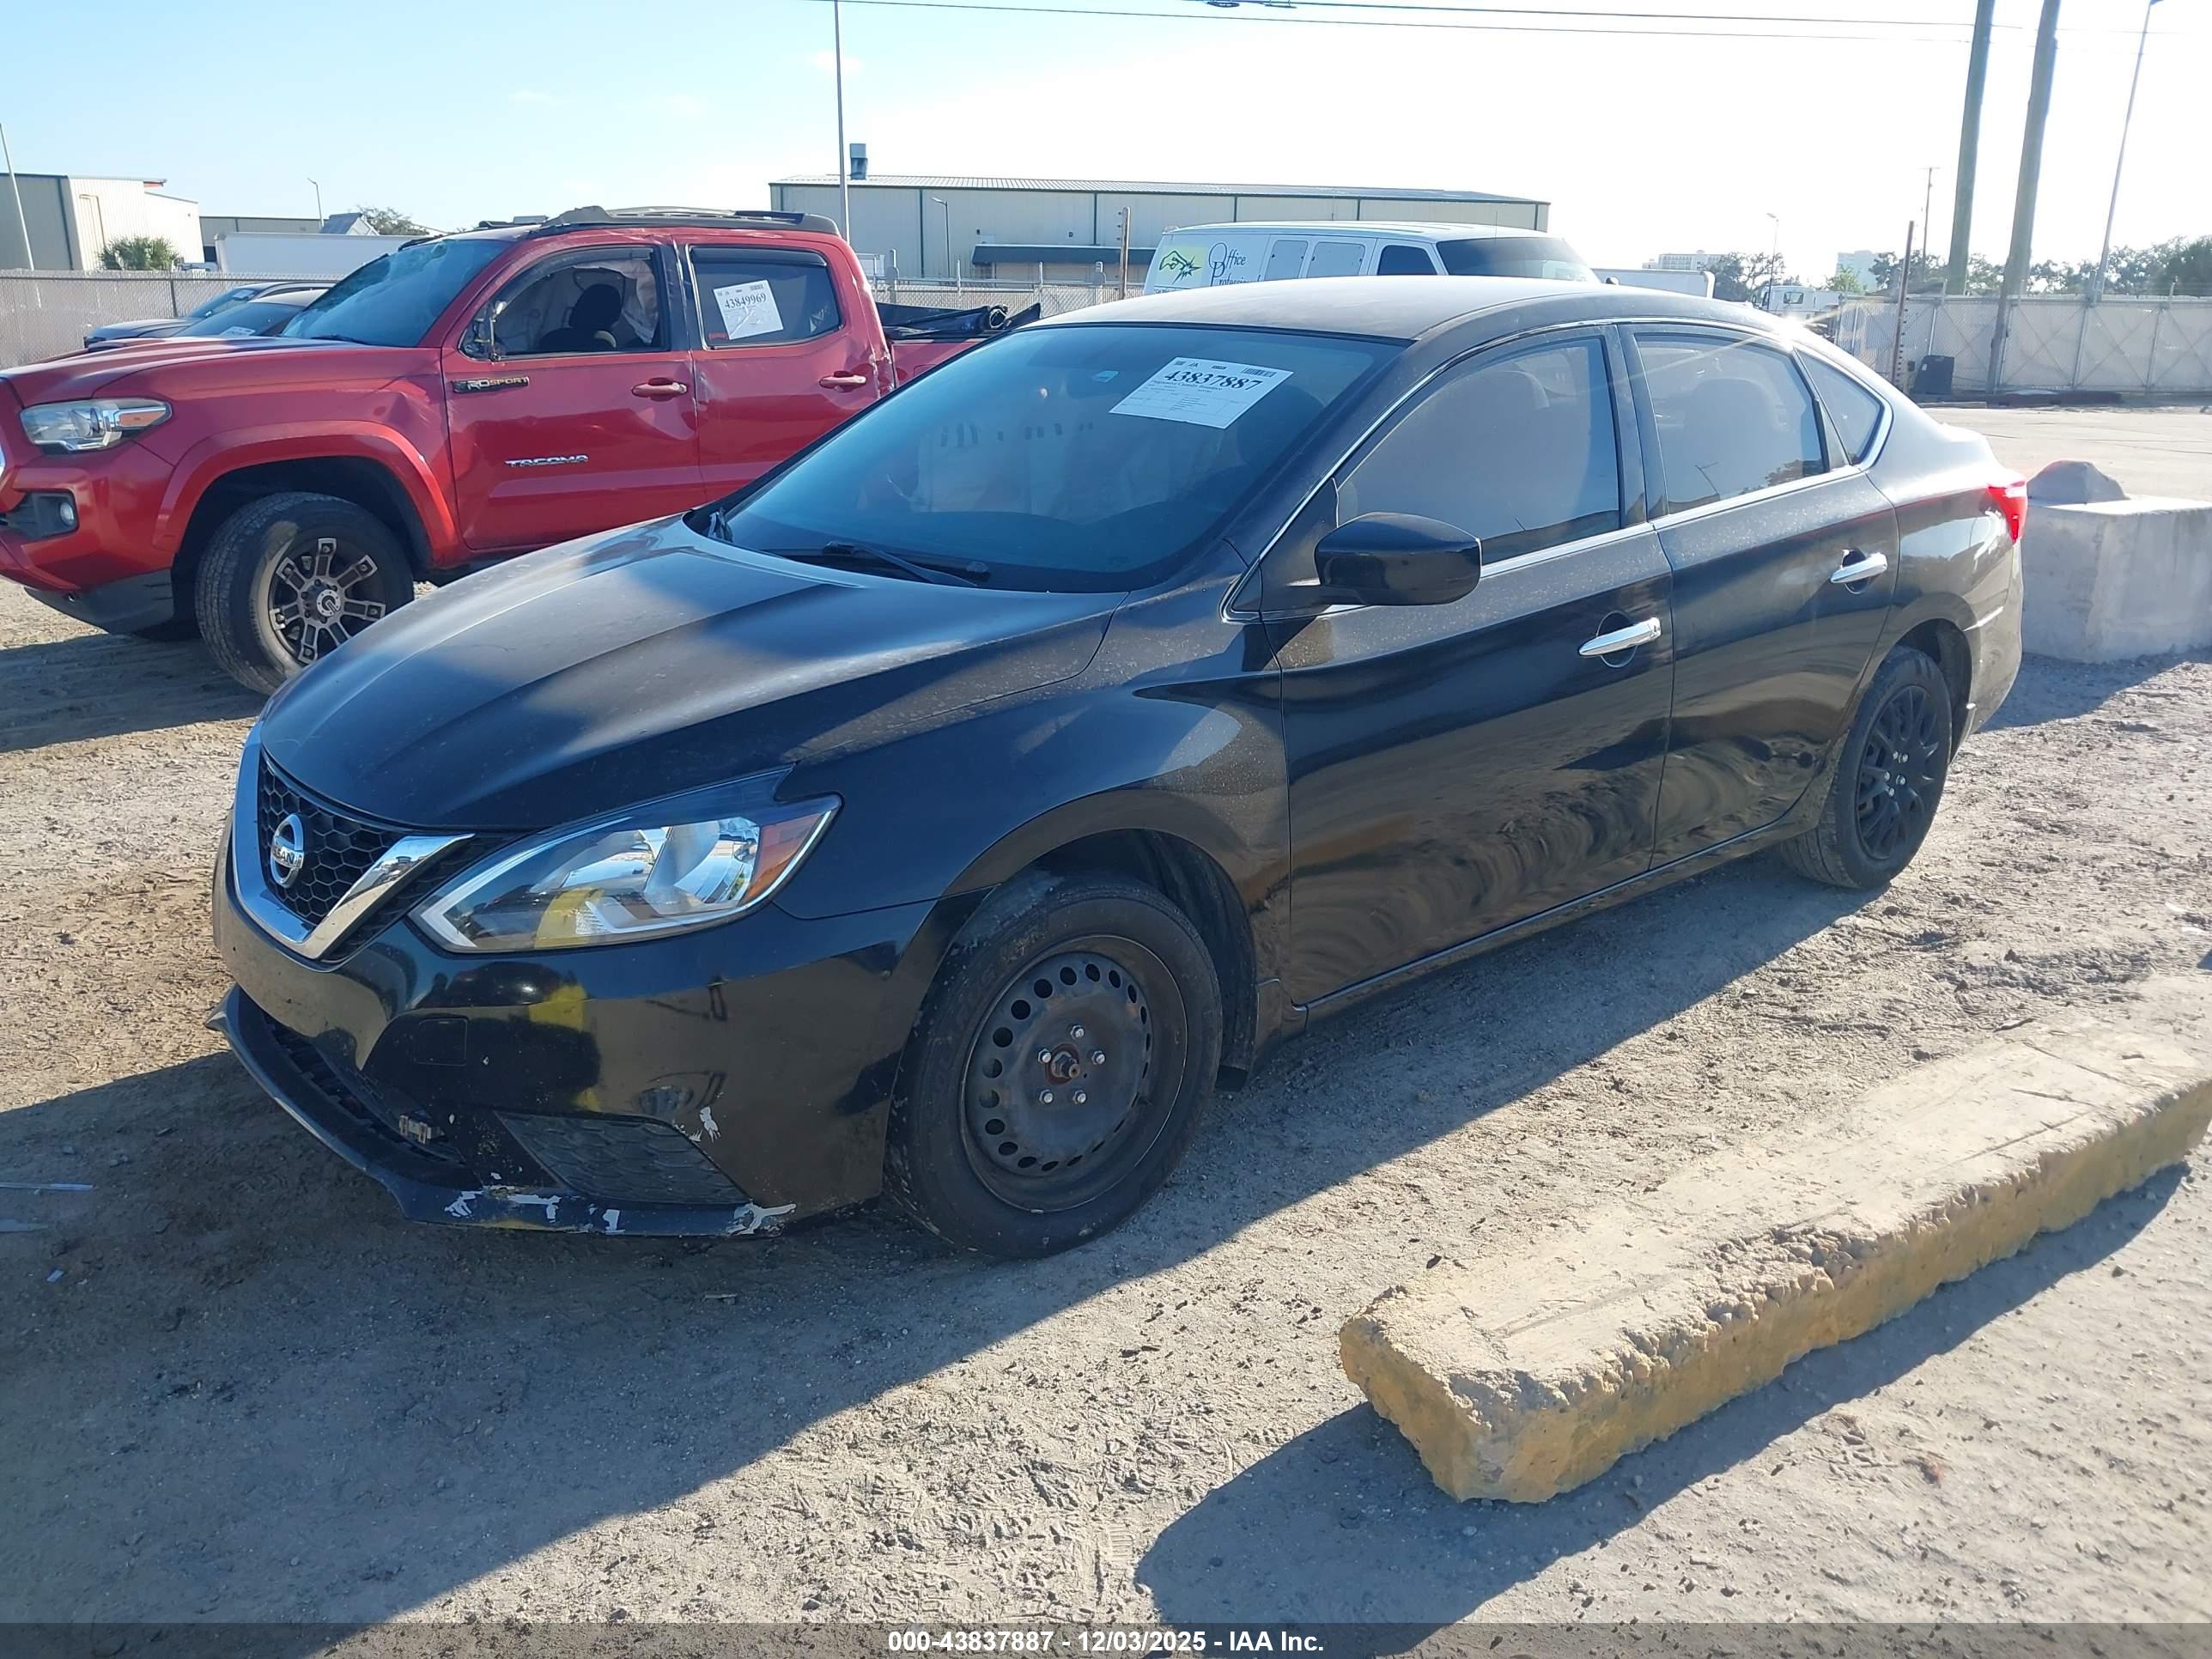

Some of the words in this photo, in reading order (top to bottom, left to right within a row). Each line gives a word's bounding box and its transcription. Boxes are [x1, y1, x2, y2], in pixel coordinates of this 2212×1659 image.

[1209, 242, 1246, 269] Office
[724, 293, 767, 309] 43849969
[1164, 370, 1263, 390] 43837887
[504, 455, 588, 467] TACOMA
